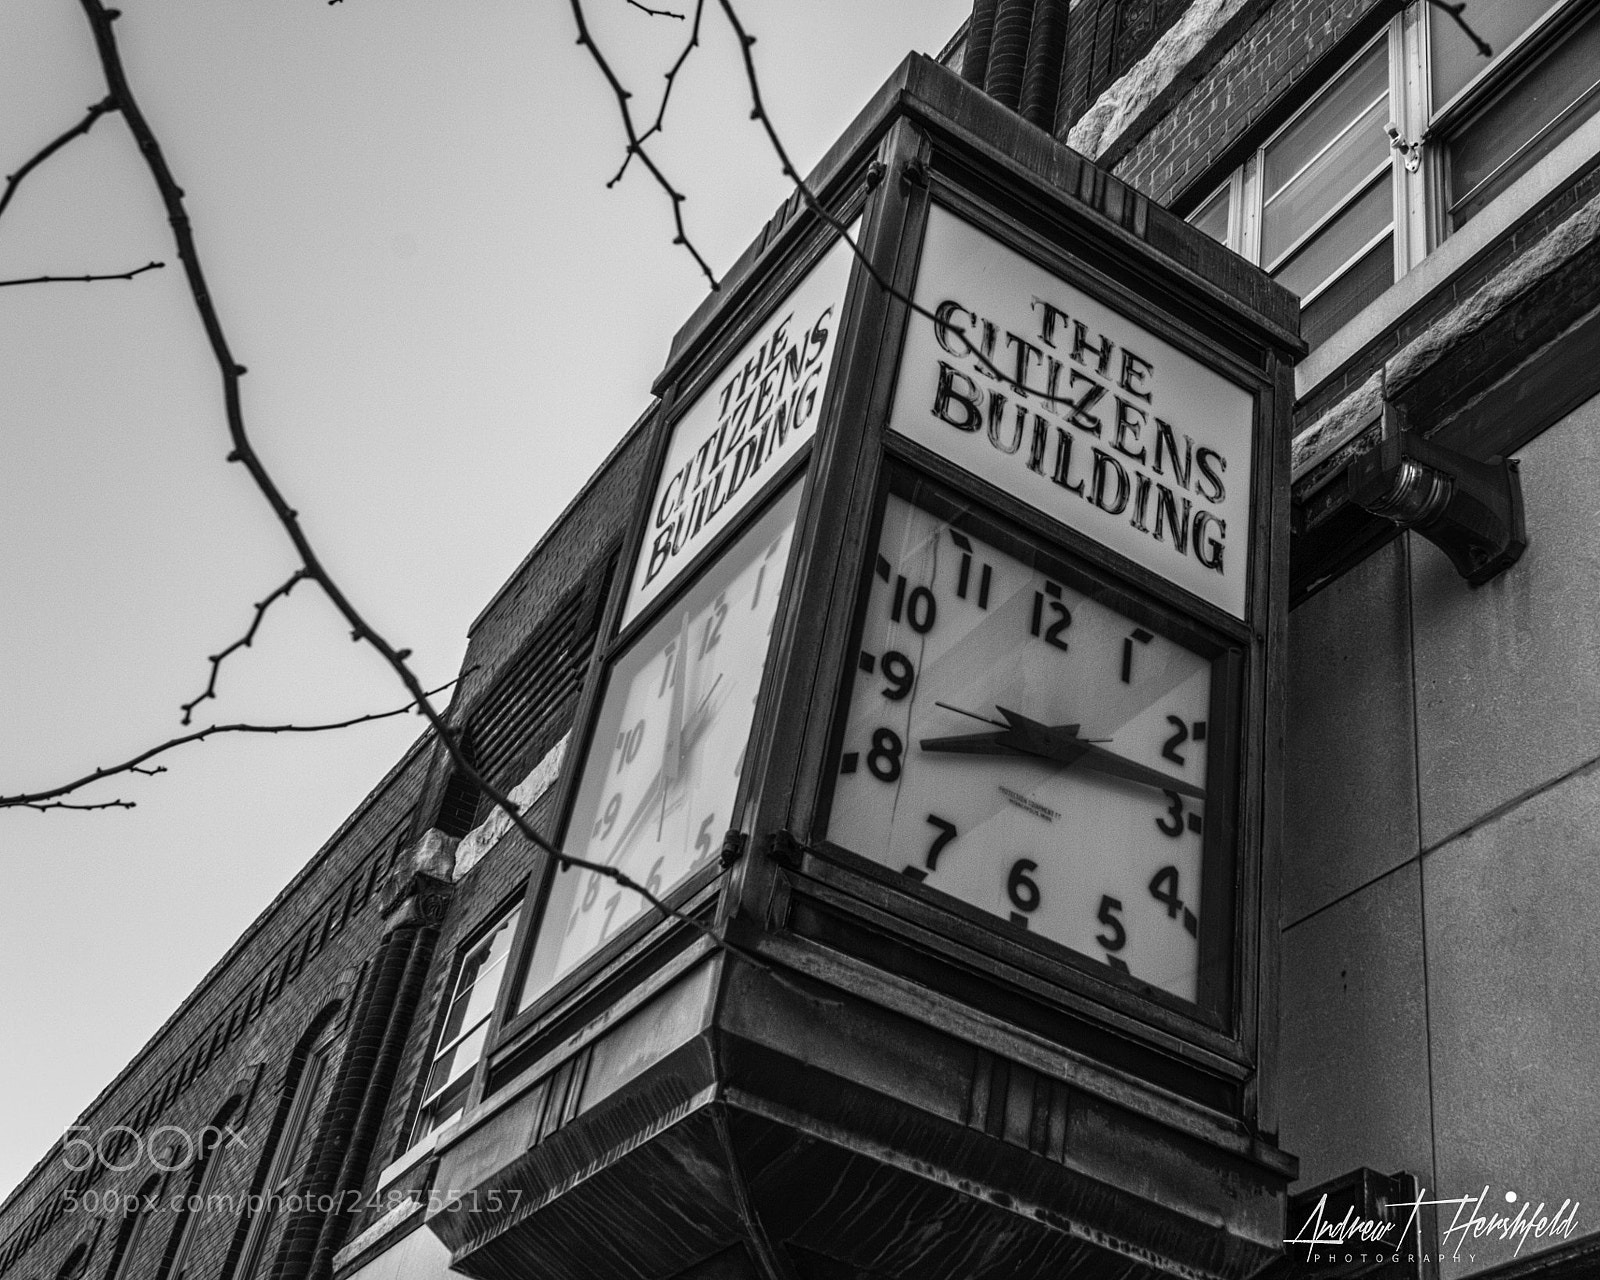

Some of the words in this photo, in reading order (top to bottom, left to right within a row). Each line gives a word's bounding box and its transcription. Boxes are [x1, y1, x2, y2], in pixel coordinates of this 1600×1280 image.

[718, 310, 795, 422] THE
[1031, 295, 1154, 405] THE
[655, 302, 836, 529] CITIZENS
[933, 299, 1227, 504] CITIZENS
[640, 361, 824, 592] BUILDING
[930, 360, 1227, 576] BUILDING
[891, 573, 937, 635] 10
[956, 552, 993, 611] 11
[698, 602, 728, 662] 12
[1029, 590, 1073, 653] 12
[880, 649, 915, 701] 9
[1121, 636, 1134, 685] 1
[617, 718, 646, 775] 10
[866, 726, 904, 783] 8
[1161, 714, 1189, 767] 2
[600, 792, 622, 841] 9
[1155, 786, 1185, 838] 3
[925, 813, 958, 872] 7
[1006, 857, 1041, 913] 6
[1148, 864, 1185, 920] 4
[1095, 893, 1127, 952] 5
